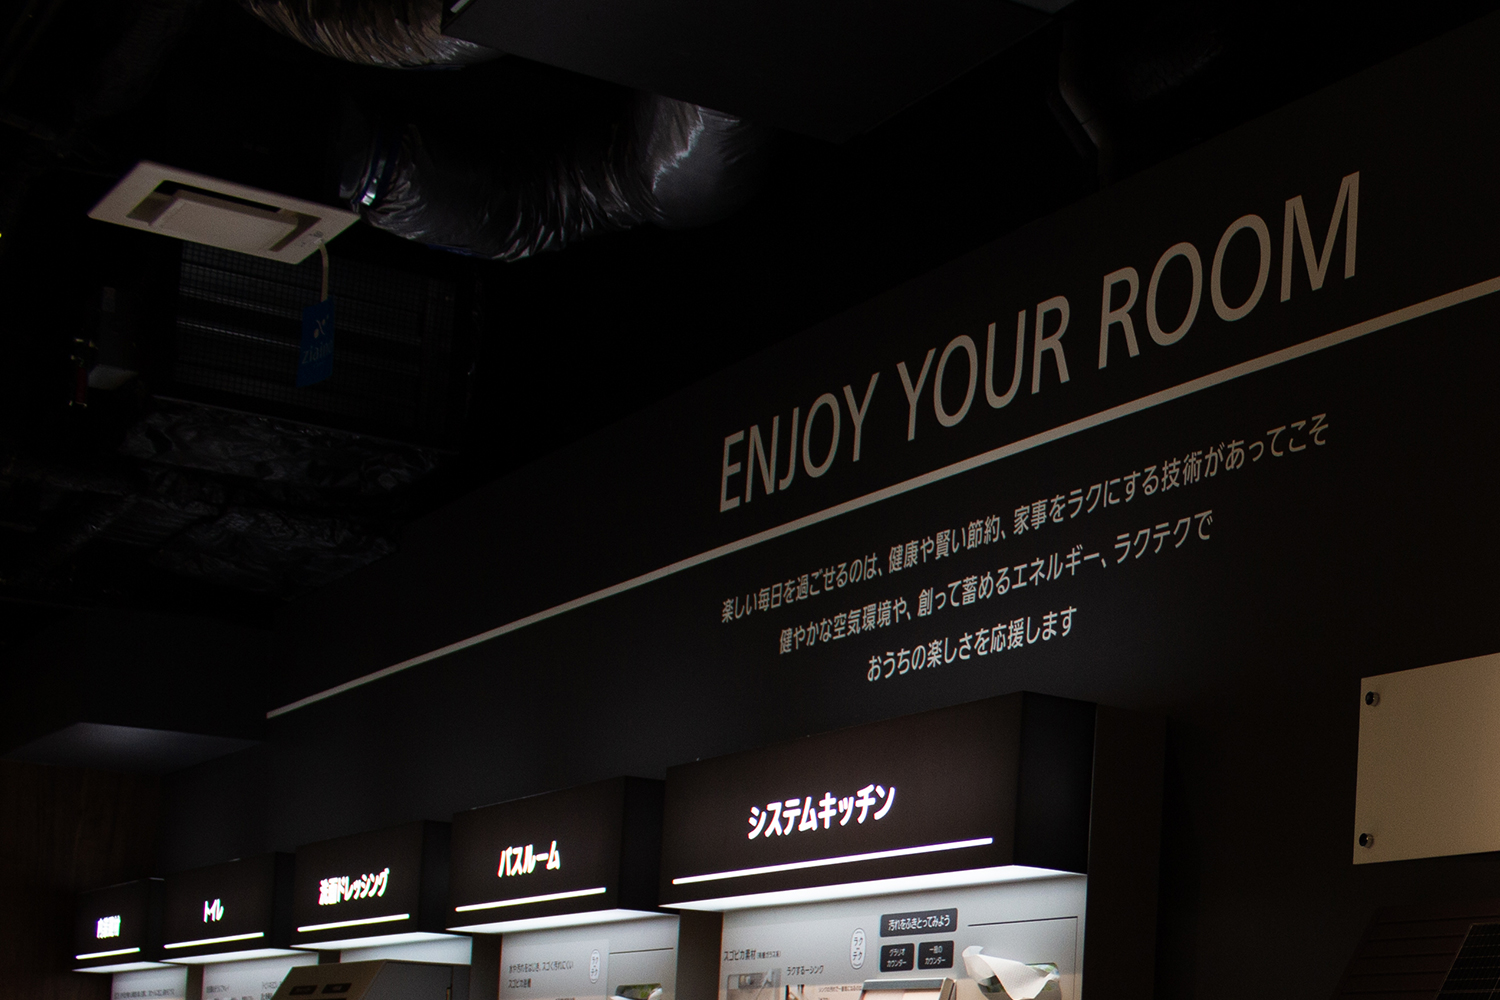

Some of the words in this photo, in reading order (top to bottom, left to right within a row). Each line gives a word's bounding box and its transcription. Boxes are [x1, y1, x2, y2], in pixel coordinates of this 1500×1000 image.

[719, 371, 880, 512] ENJOY
[897, 295, 1070, 441] YOUR
[1099, 171, 1360, 369] ROOM
[867, 606, 1078, 682] おうちの楽しさを応援します
[747, 784, 896, 840] システムキッチン
[498, 840, 560, 877] バスルーム
[203, 898, 225, 923] トイレ
[888, 914, 950, 931] 汚れをふきとってみよう
